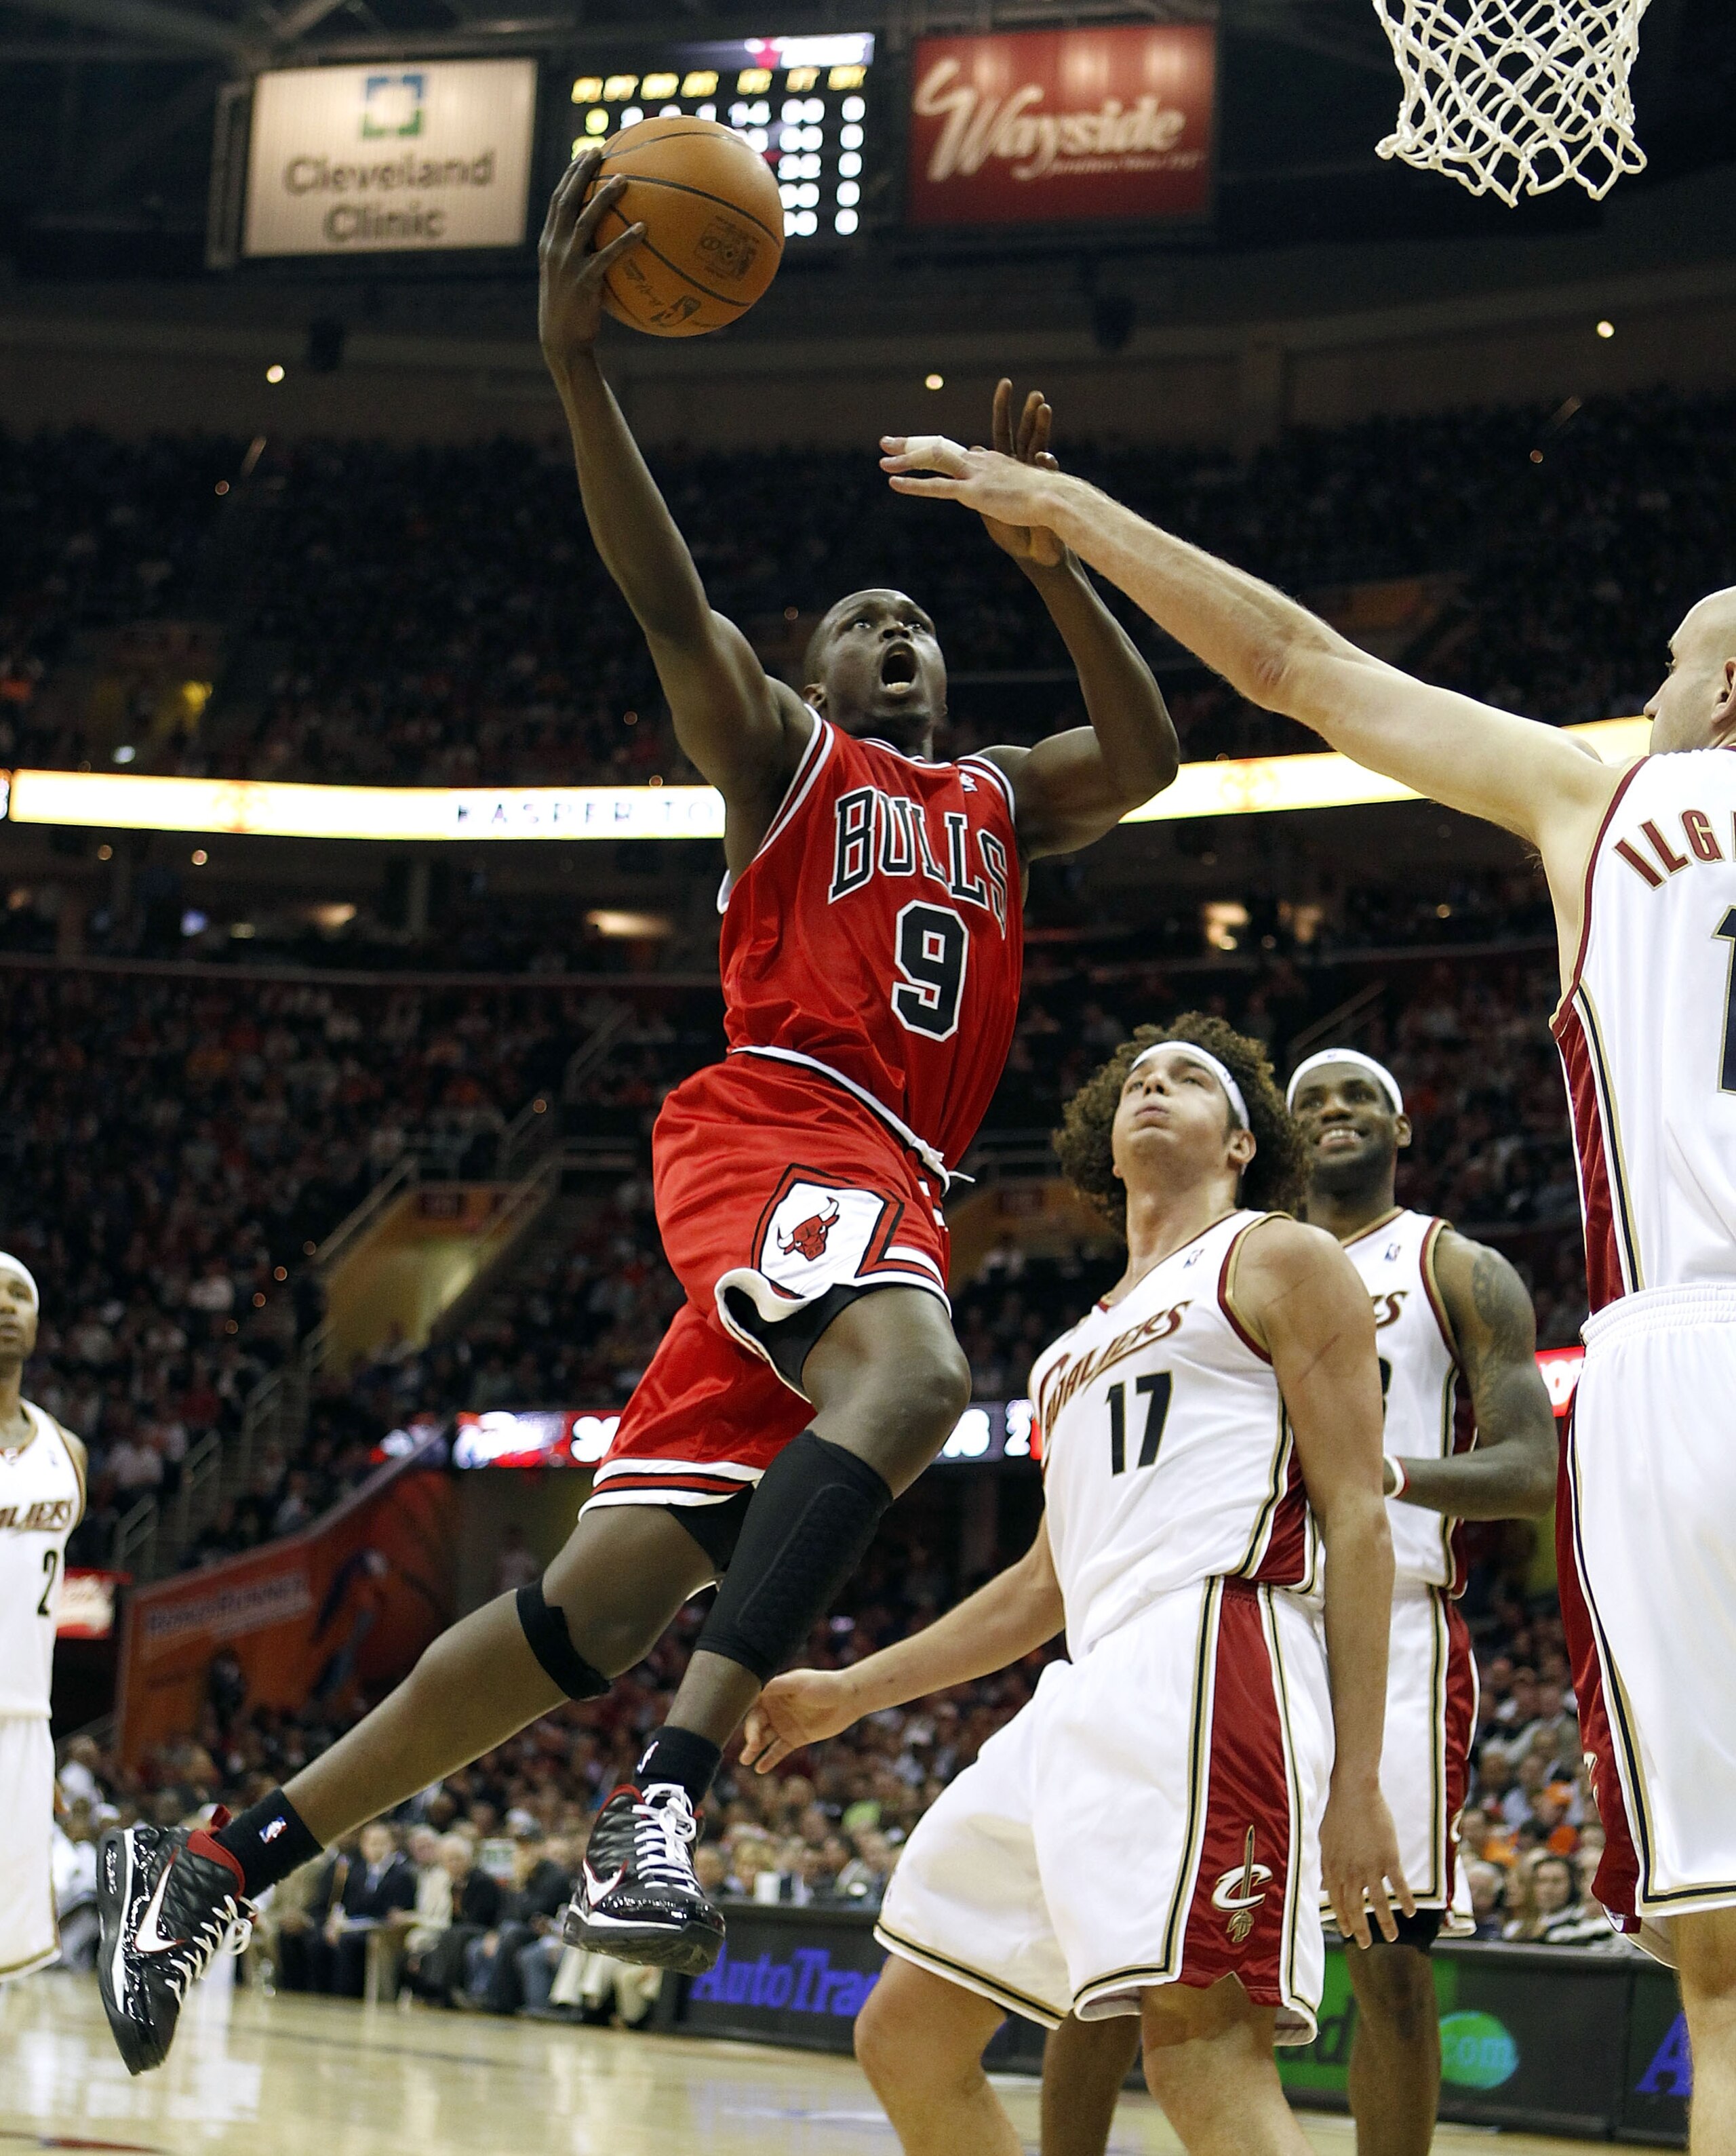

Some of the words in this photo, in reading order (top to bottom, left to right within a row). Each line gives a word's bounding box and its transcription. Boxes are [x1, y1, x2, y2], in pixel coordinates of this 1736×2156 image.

[913, 58, 1187, 182] Wayside
[282, 148, 496, 195] Cleveland
[322, 201, 448, 243] Clinic
[827, 785, 1010, 941] BULLS
[1611, 809, 1736, 892] ILG
[890, 899, 970, 1043] 9
[1105, 1370, 1174, 1479] 17
[37, 1549, 58, 1617] 2
[1635, 2010, 1693, 2096] A
